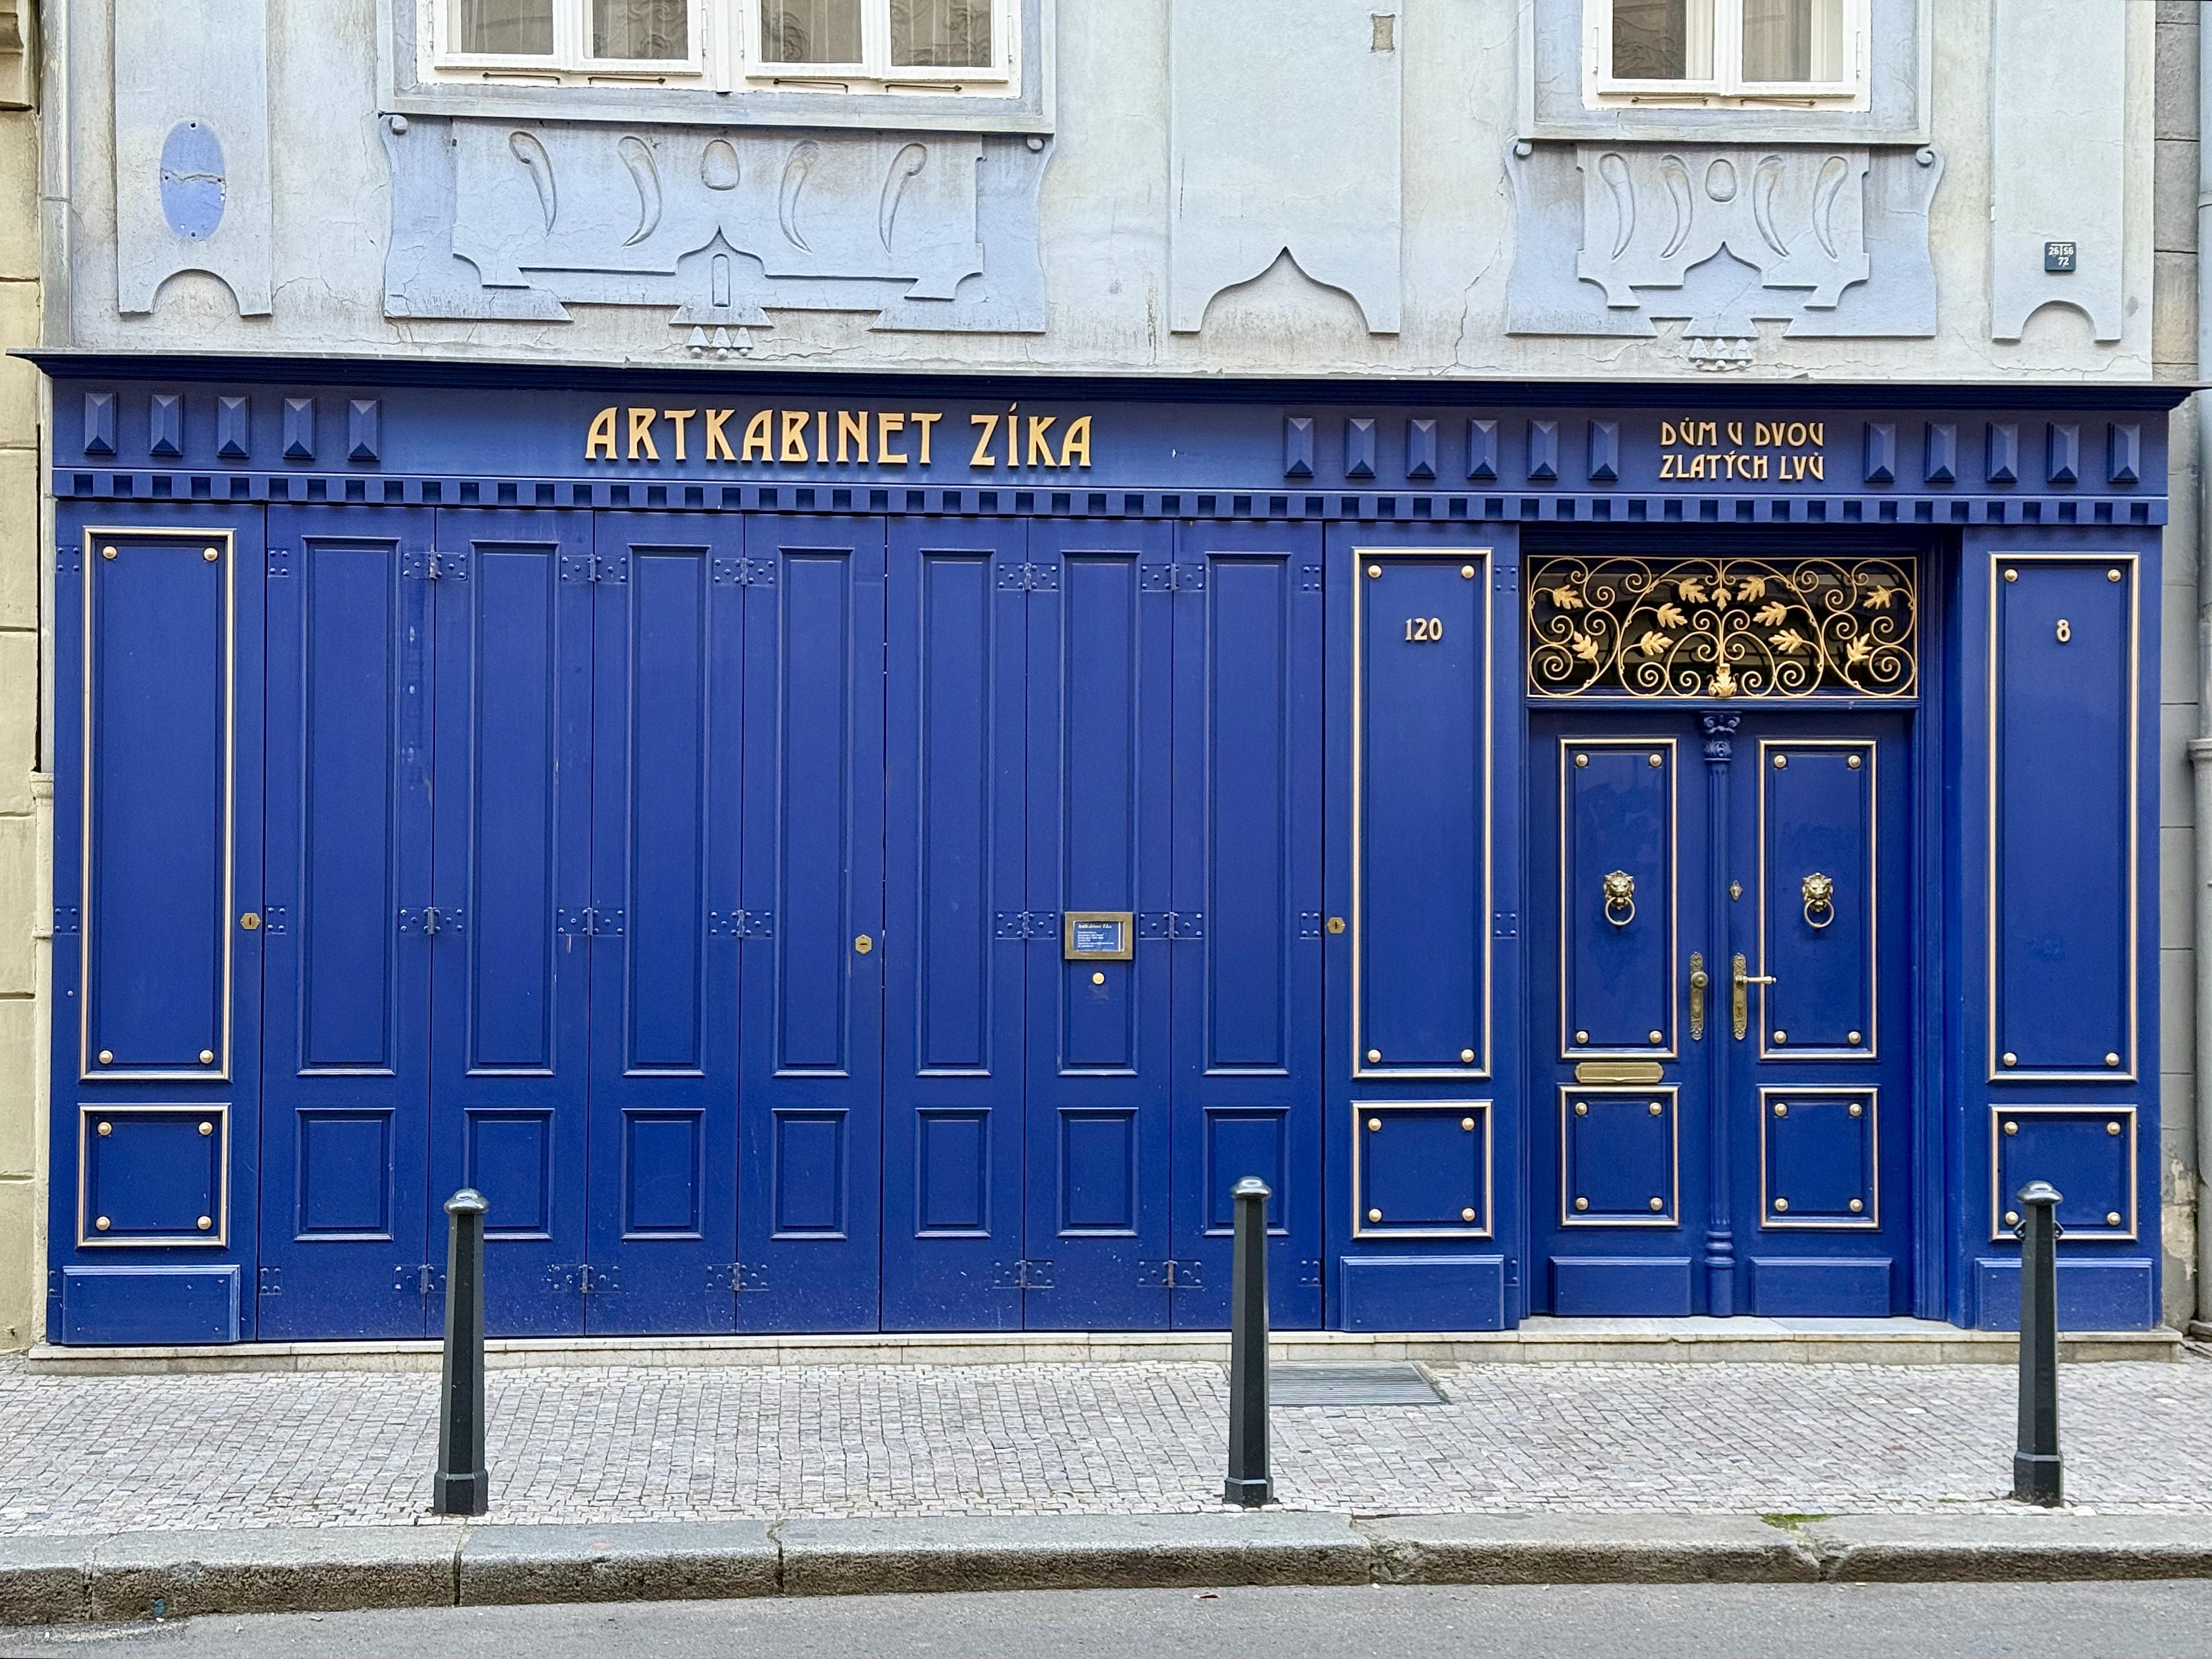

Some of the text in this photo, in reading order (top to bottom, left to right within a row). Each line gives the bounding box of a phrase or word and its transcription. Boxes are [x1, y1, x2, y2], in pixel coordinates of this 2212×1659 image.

[2048, 246, 2060, 255] 26
[2058, 256, 2070, 265] 72
[585, 402, 1094, 468] ARTKABINET ZÍKA
[1660, 416, 1824, 447] DŮM U DVOU
[1659, 450, 1824, 481] ZLATÝCH LVŮ
[1405, 617, 1443, 641] 120
[2056, 618, 2071, 643] 8
